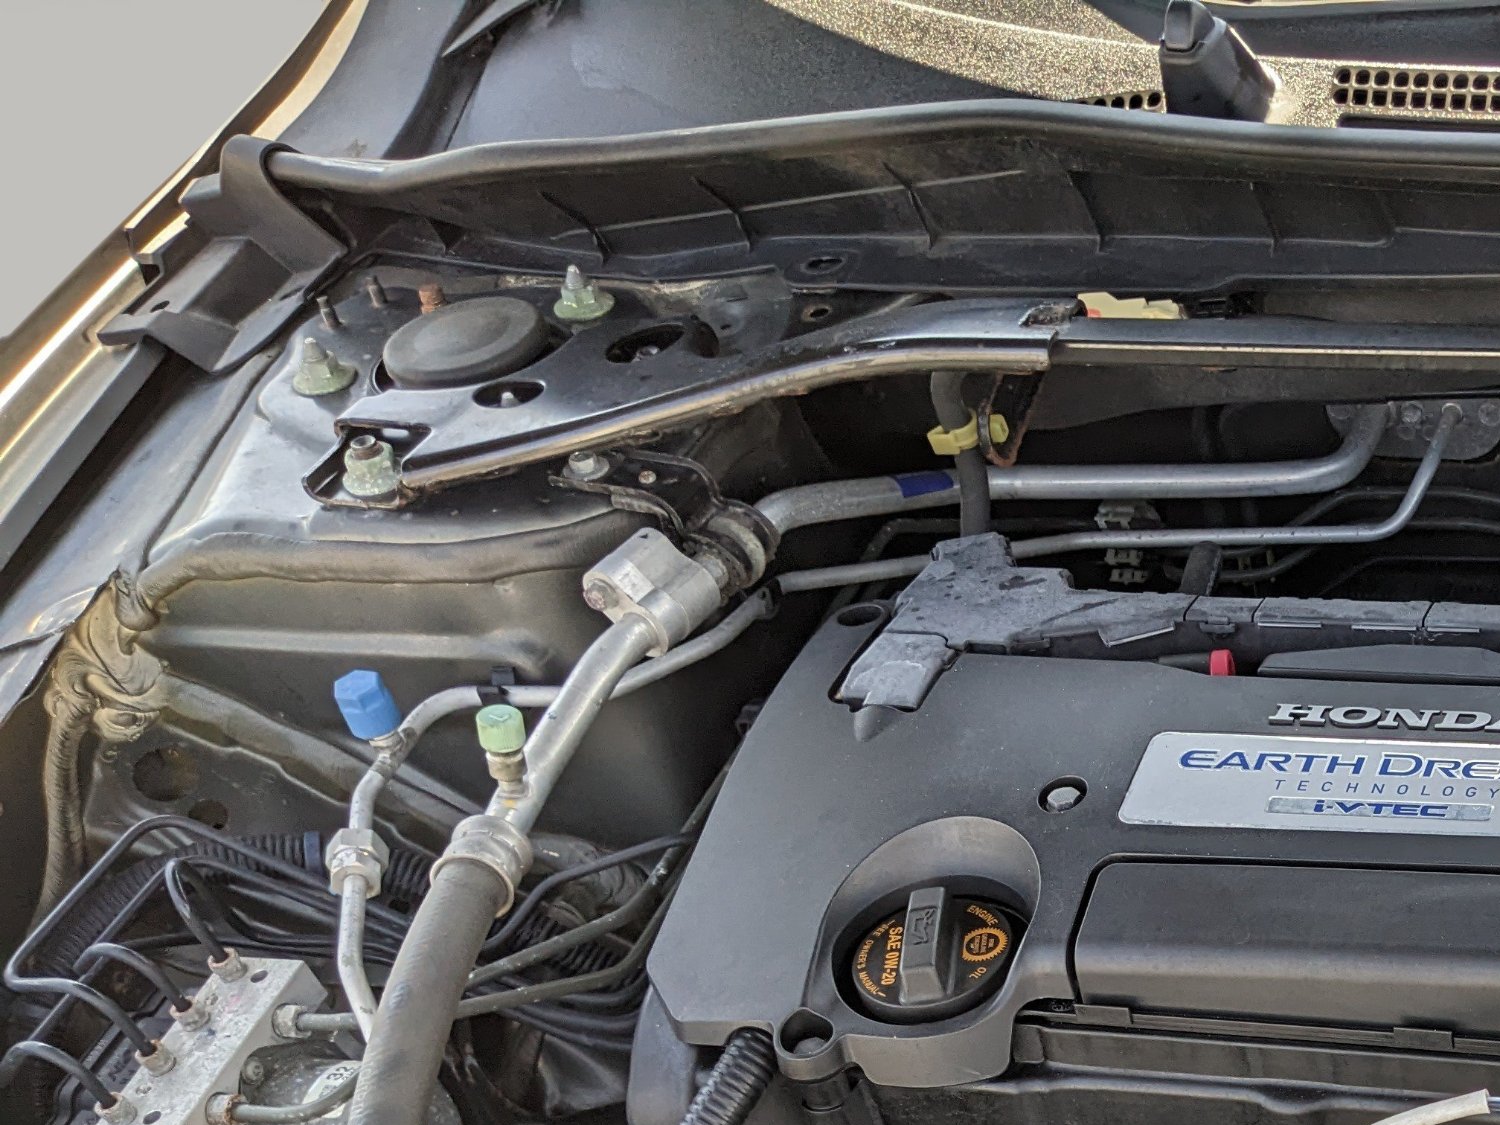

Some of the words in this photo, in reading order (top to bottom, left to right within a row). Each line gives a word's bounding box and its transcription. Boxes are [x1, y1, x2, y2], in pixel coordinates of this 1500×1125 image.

[1180, 749, 1364, 778] EARTH
[1313, 798, 1449, 818] i-VTEC
[966, 905, 999, 926] ENGINE
[886, 926, 904, 950] SAE
[880, 952, 900, 986] 0W-20
[968, 966, 988, 979] OIL
